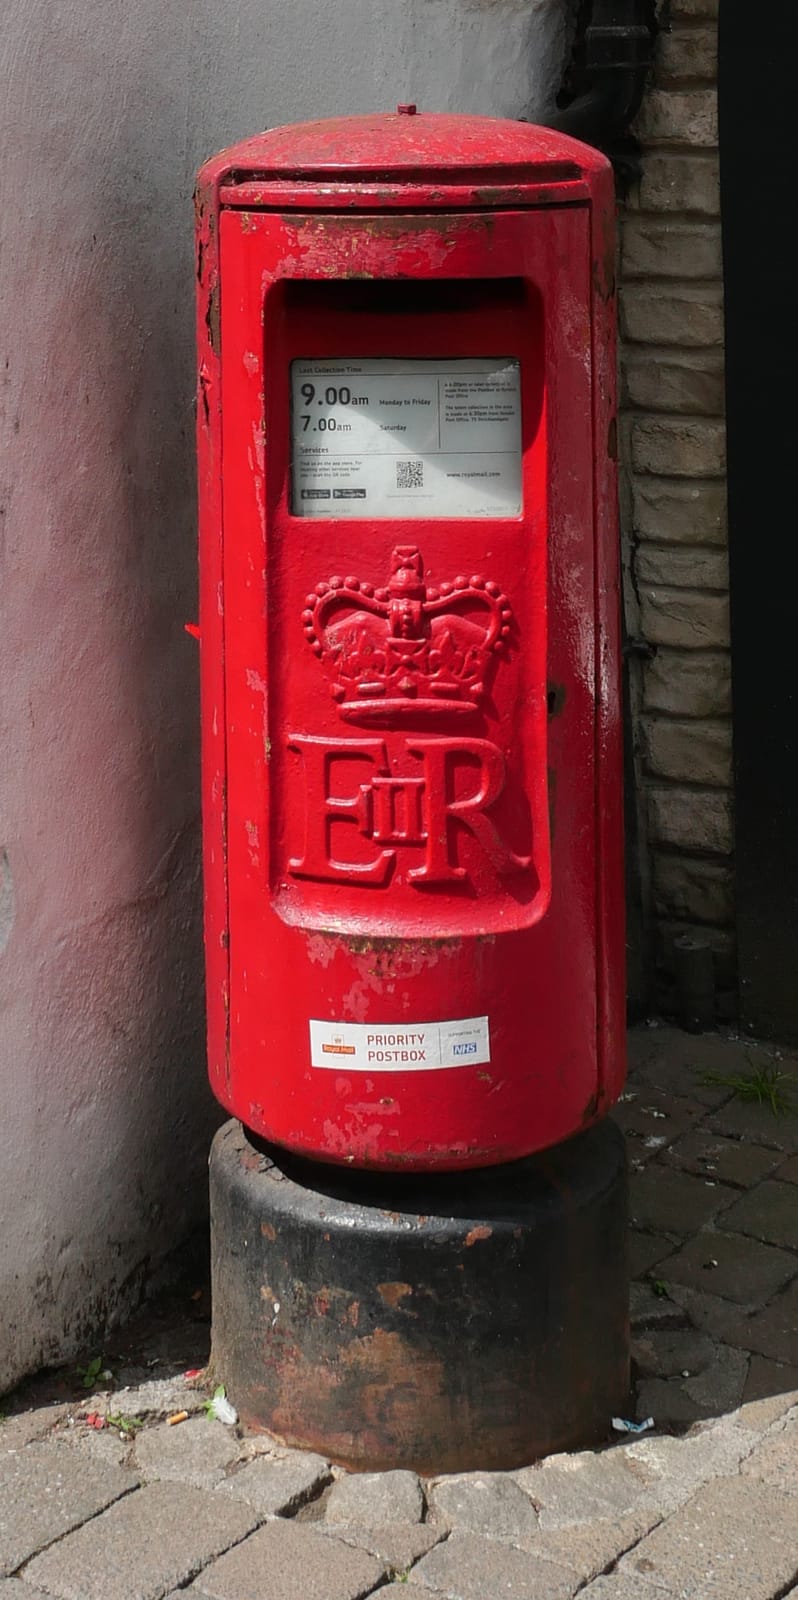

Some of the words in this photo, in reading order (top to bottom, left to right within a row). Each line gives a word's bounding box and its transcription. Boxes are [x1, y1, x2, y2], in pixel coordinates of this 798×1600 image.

[314, 366, 345, 374] Collection
[301, 383, 369, 406] 9.00am
[300, 415, 352, 432] 7.00am
[367, 1034, 425, 1046] PRIORITY
[454, 1043, 475, 1054] NHS
[368, 1050, 426, 1062] POSTBOX
